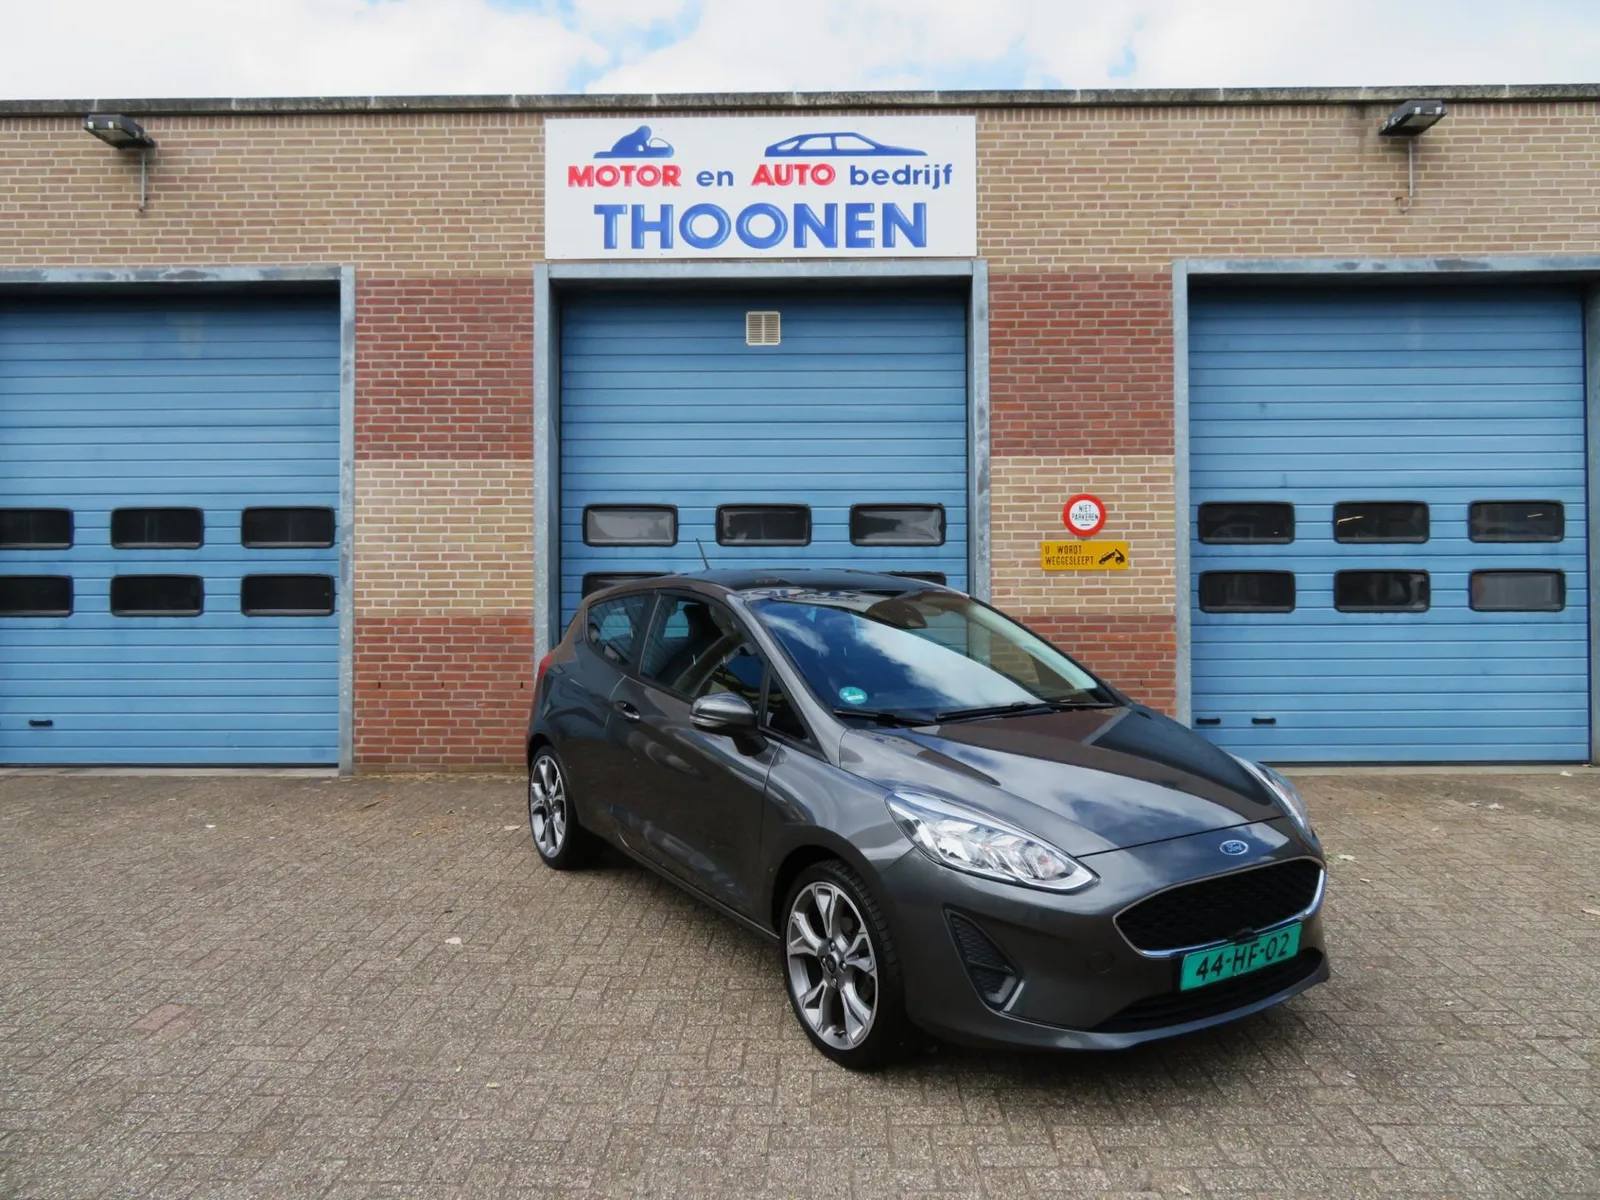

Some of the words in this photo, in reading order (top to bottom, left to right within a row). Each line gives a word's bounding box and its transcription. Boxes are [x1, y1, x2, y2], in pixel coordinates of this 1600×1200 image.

[567, 164, 682, 188] MOTOR
[696, 170, 734, 187] en
[751, 163, 836, 187] AUTO
[850, 163, 953, 190] bedrijf
[593, 202, 928, 250] THOONEN
[1078, 504, 1092, 513] NIET
[1071, 512, 1099, 521] PARKEREN
[1045, 545, 1050, 555] U
[1057, 545, 1082, 555] WORDT
[1045, 555, 1094, 566] WEGGESLEEPT
[1195, 932, 1290, 981] 44-HF-02
